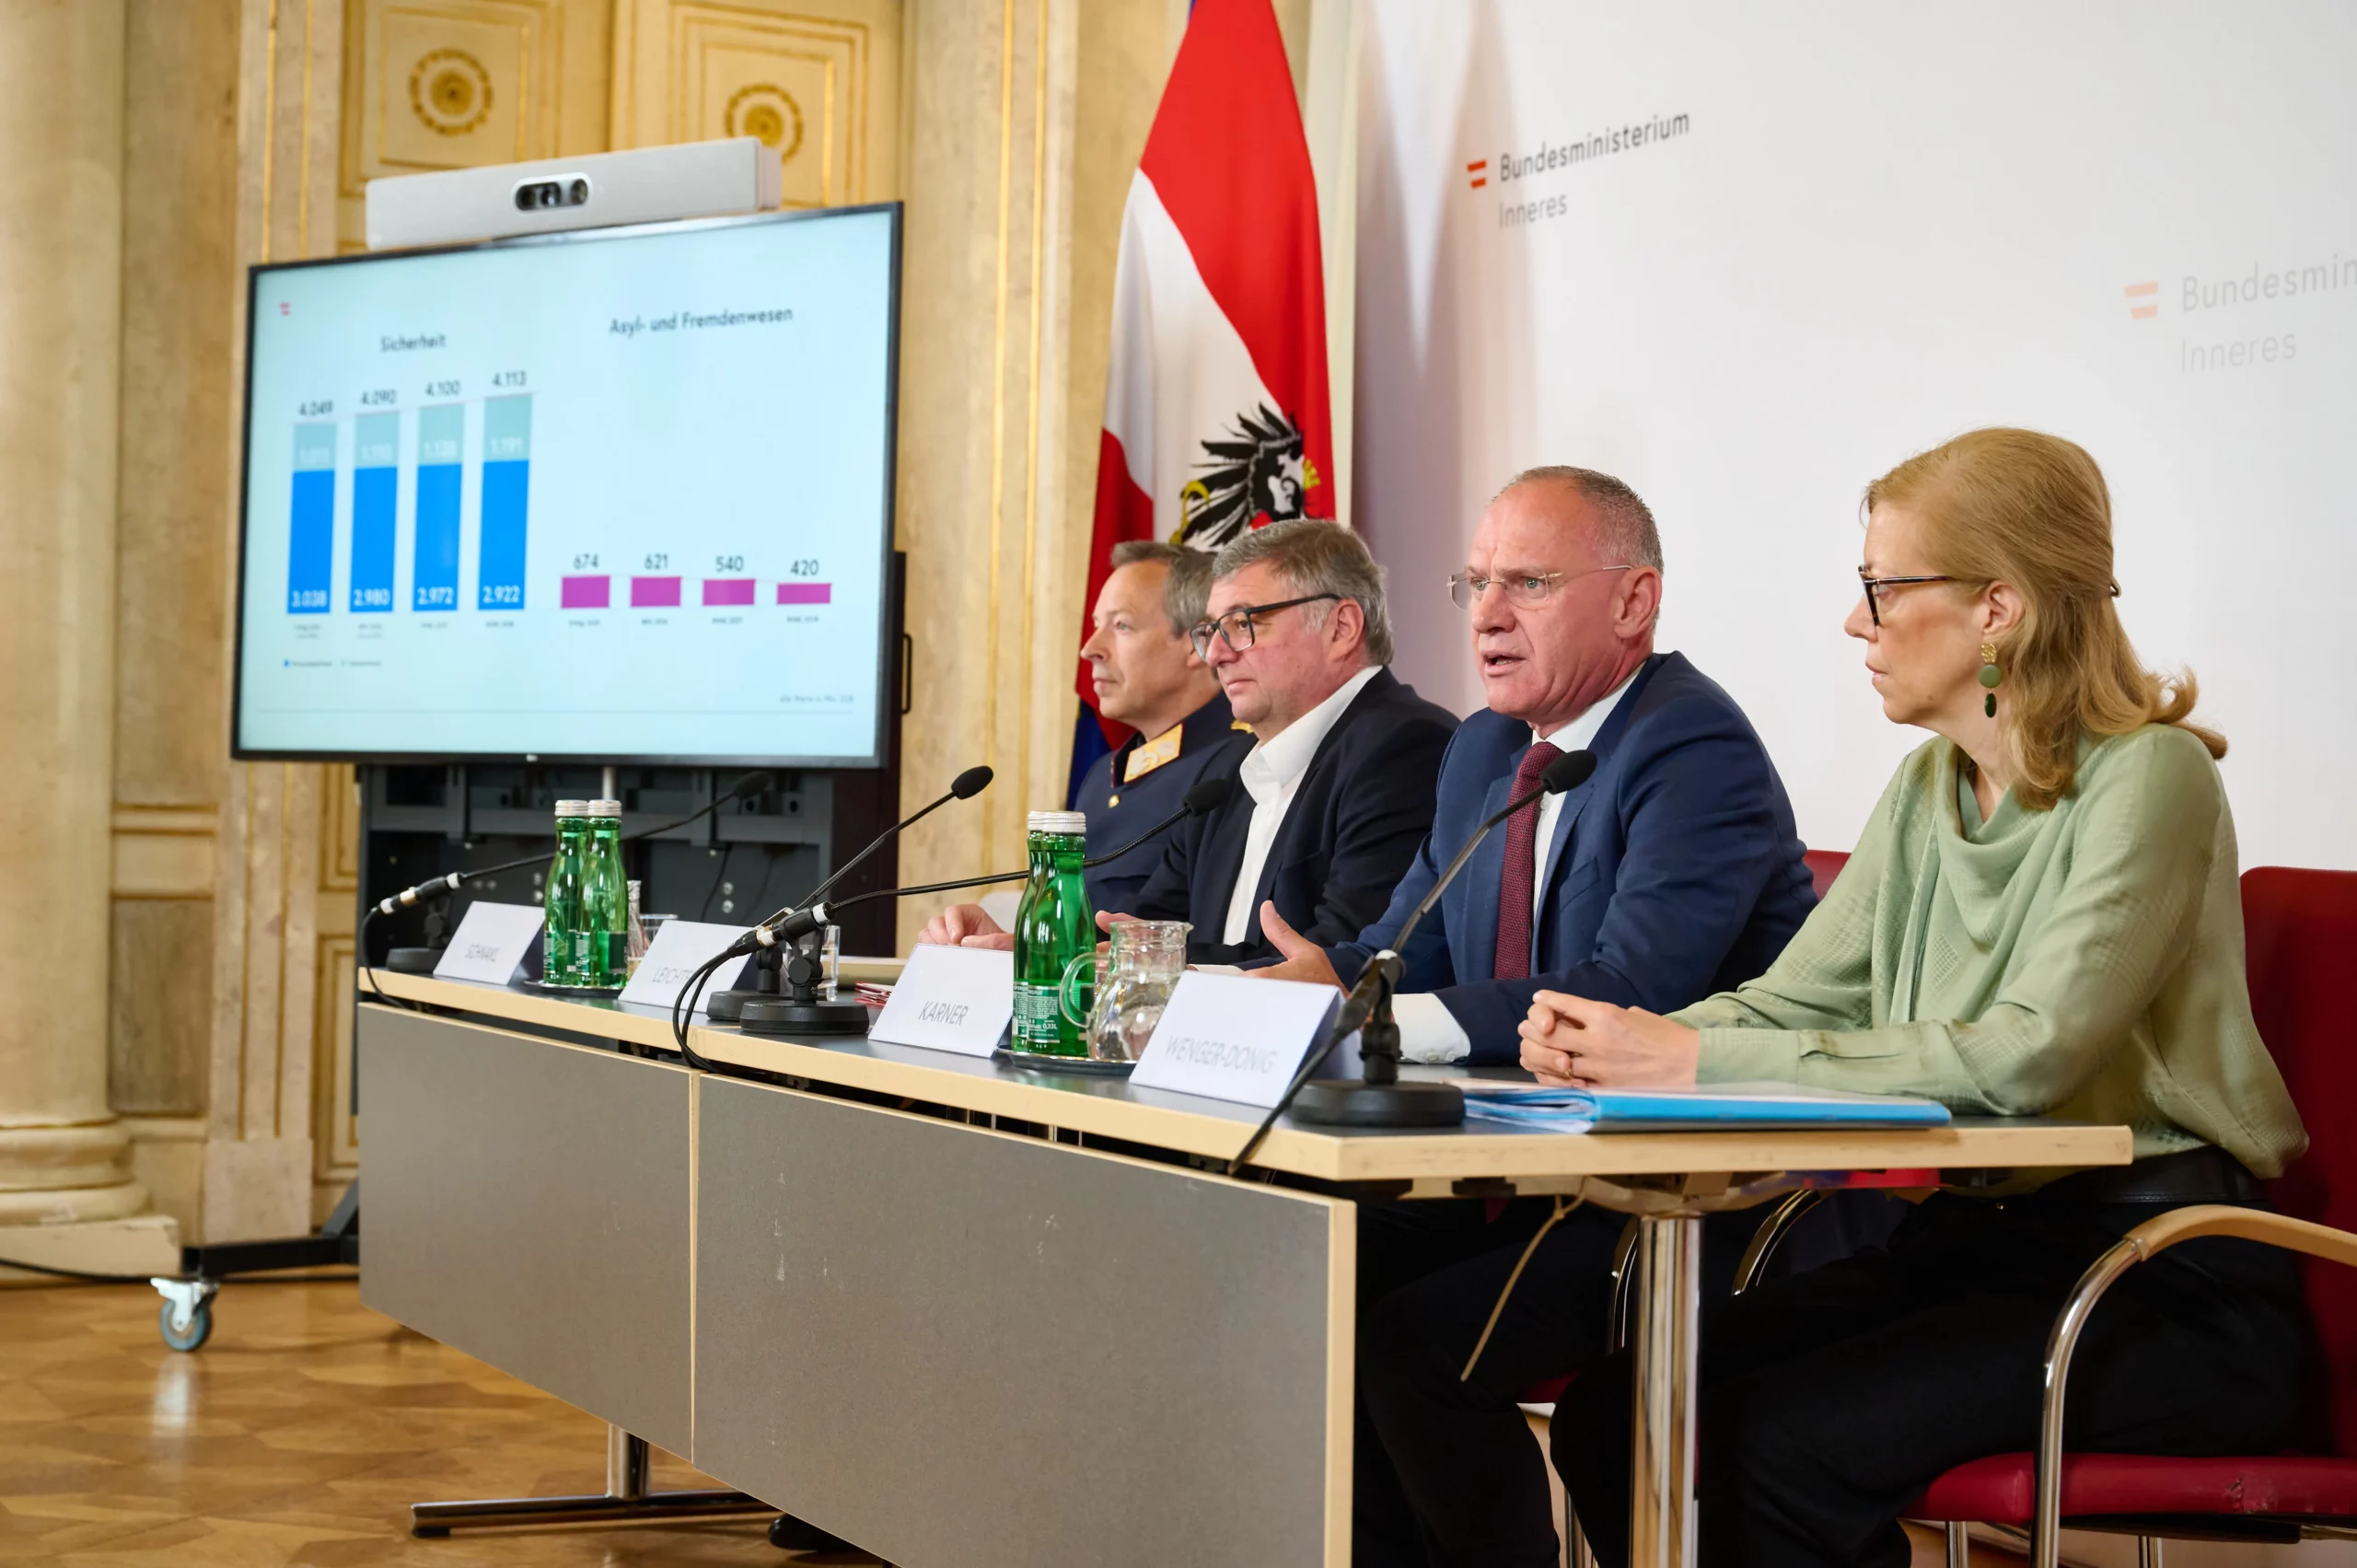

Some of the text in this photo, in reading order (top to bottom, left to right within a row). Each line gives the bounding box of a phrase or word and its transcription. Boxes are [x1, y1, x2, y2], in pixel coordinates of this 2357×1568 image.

[1500, 112, 1690, 182] Bundesministerium
[1499, 193, 1568, 229] Inneres
[610, 307, 794, 338] Asyl- und Fremdenwesen
[380, 332, 447, 353] Sicherheit
[2181, 332, 2297, 374] Inneres
[424, 380, 461, 397] 4.100
[492, 370, 527, 387] 4.113
[574, 554, 599, 569] 674
[644, 553, 668, 569] 621
[715, 555, 745, 572] 540
[790, 560, 819, 576] 420
[354, 587, 390, 607] 2.980
[417, 587, 455, 606] 2.972
[482, 586, 521, 604] 2.922
[651, 966, 712, 988] LEICHTF
[918, 1001, 969, 1026] KARNER
[1166, 1035, 1278, 1074] WENGER-DONIG
